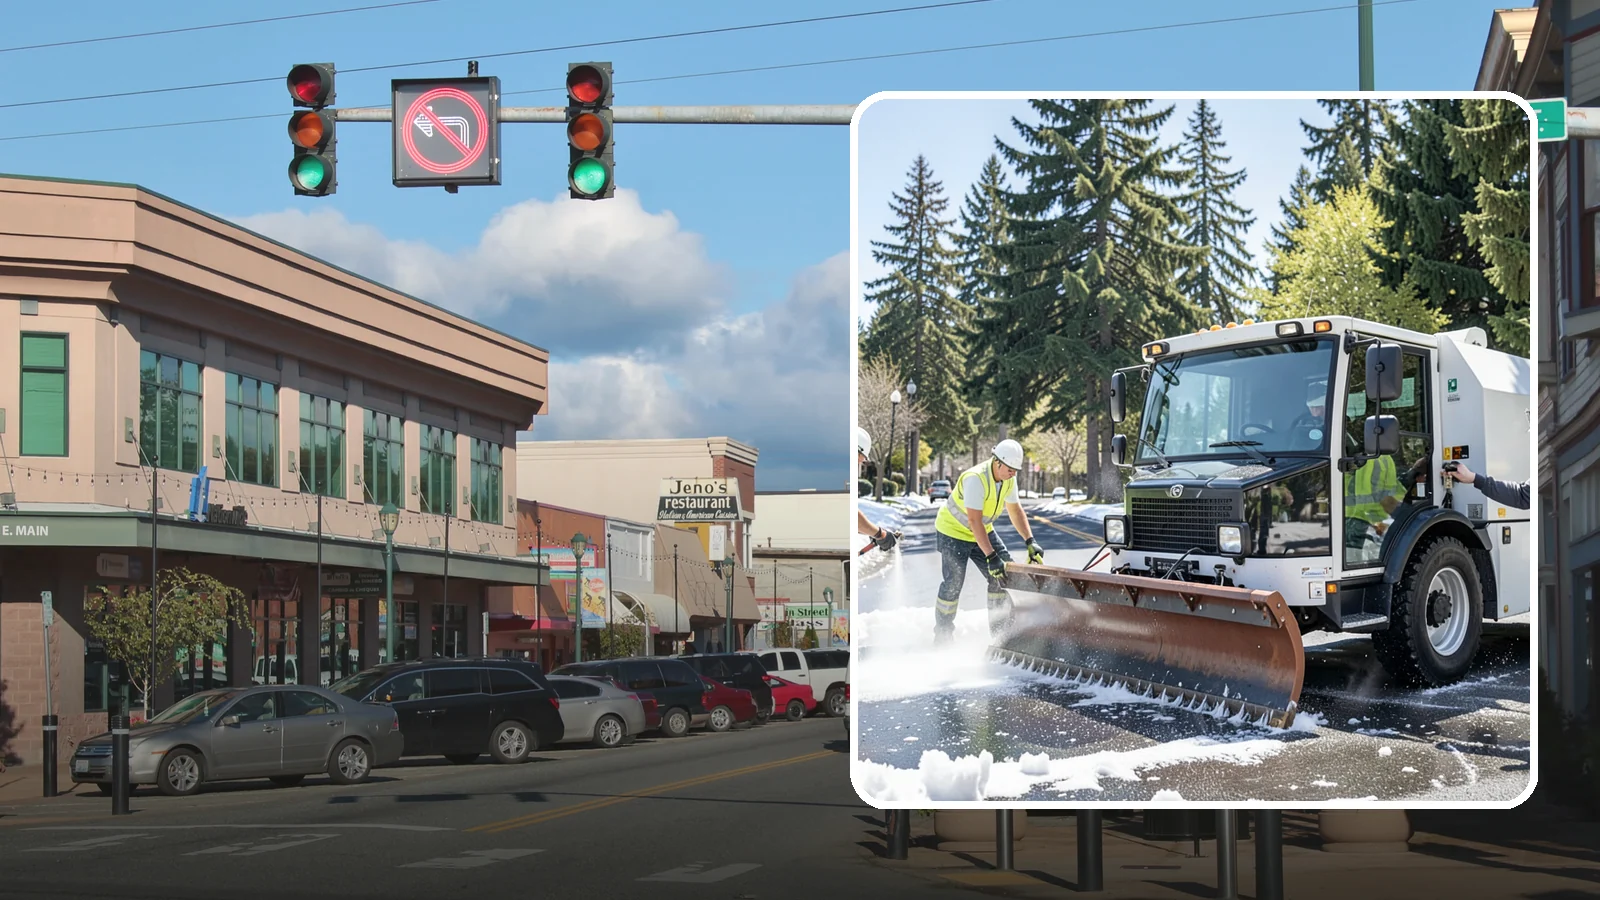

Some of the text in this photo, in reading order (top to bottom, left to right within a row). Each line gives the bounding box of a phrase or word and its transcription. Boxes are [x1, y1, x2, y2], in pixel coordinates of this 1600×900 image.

[669, 480, 727, 494] Jeno's
[665, 496, 731, 509] restaurant
[686, 509, 714, 519] American
[715, 509, 737, 519] Cuisine
[2, 525, 49, 536] E. MAIN
[786, 607, 795, 616] in
[797, 607, 828, 616] Street
